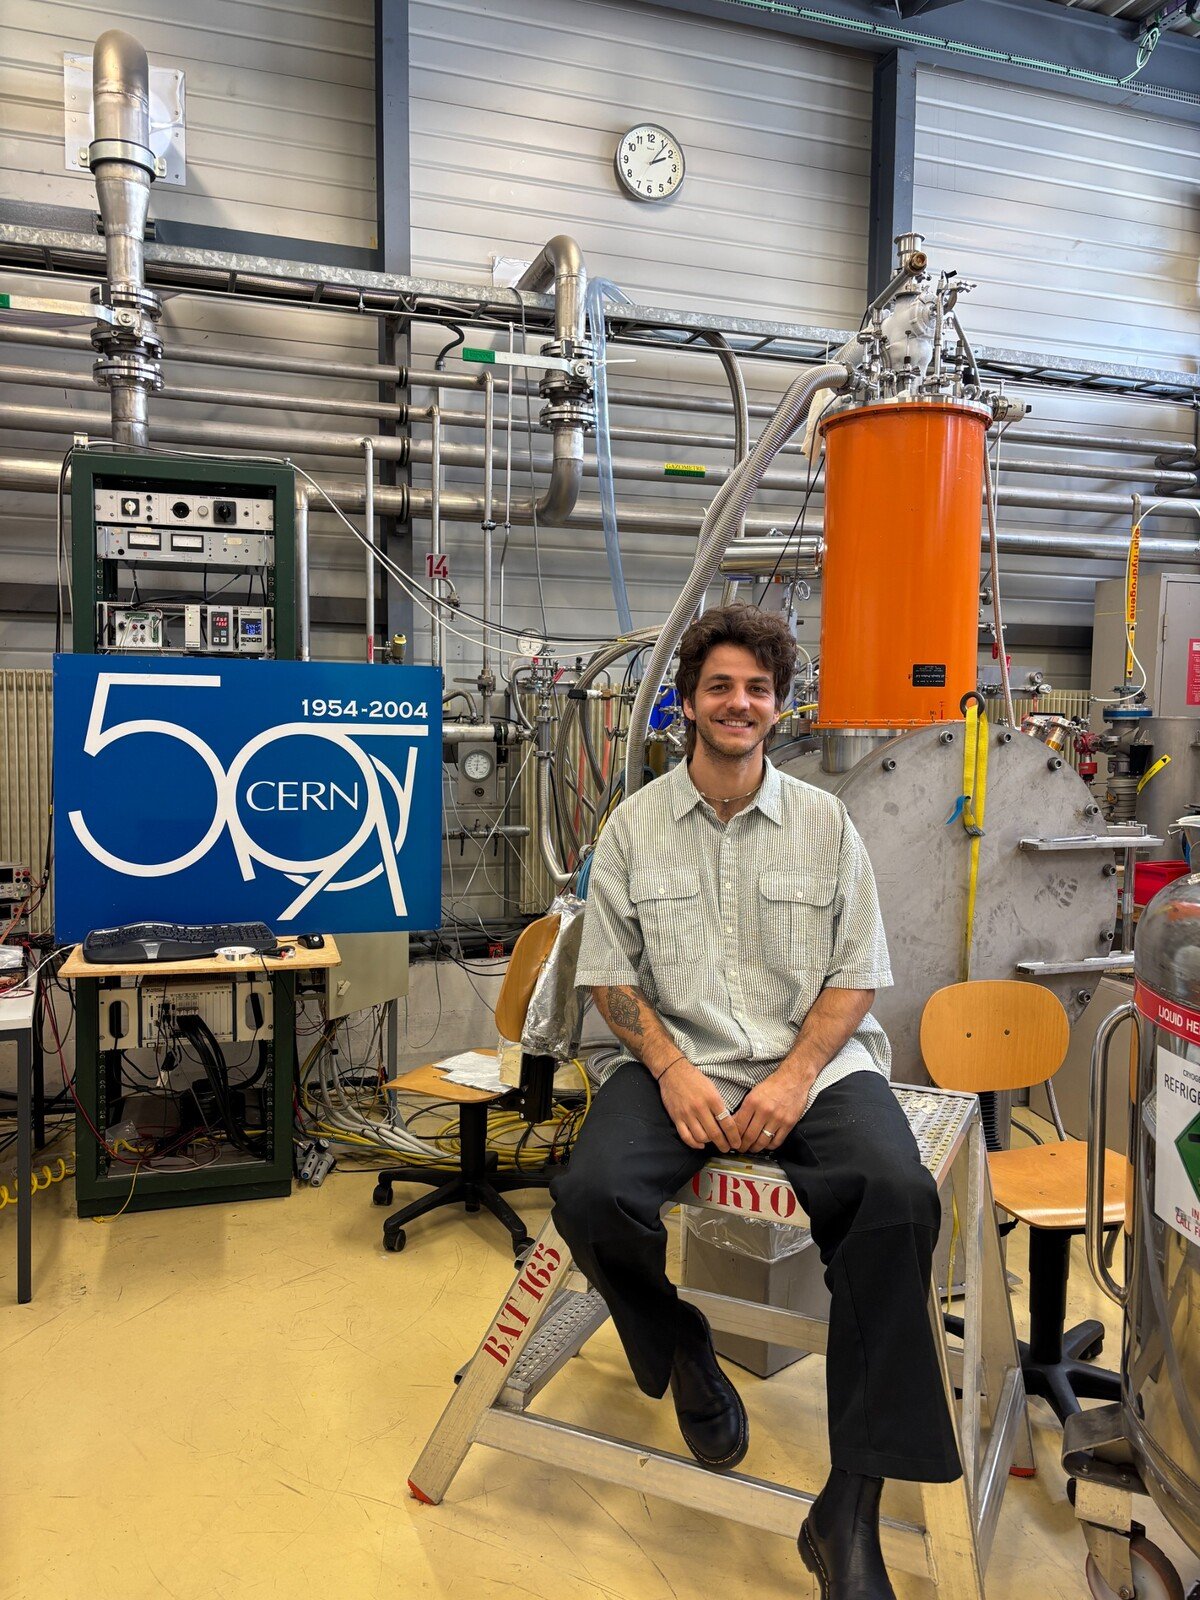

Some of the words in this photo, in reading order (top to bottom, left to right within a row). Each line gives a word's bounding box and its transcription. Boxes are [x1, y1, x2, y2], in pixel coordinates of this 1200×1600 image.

[636, 136, 643, 144] 11
[647, 133, 656, 143] 12
[628, 142, 636, 152] 10
[623, 154, 629, 164] 9
[667, 150, 674, 159] 2
[627, 169, 633, 178] 8
[671, 164, 677, 173] 3
[636, 180, 642, 189] 7
[667, 176, 672, 185] 4
[646, 185, 652, 193] 6
[658, 184, 664, 192] 5
[426, 555, 448, 578] 14
[301, 699, 428, 718] 1954-2004
[246, 781, 359, 812] CERN
[1158, 1005, 1183, 1027] LIQUID
[691, 1171, 797, 1219] CRYO
[482, 1296, 531, 1367] BAT
[518, 1242, 561, 1303] 165
